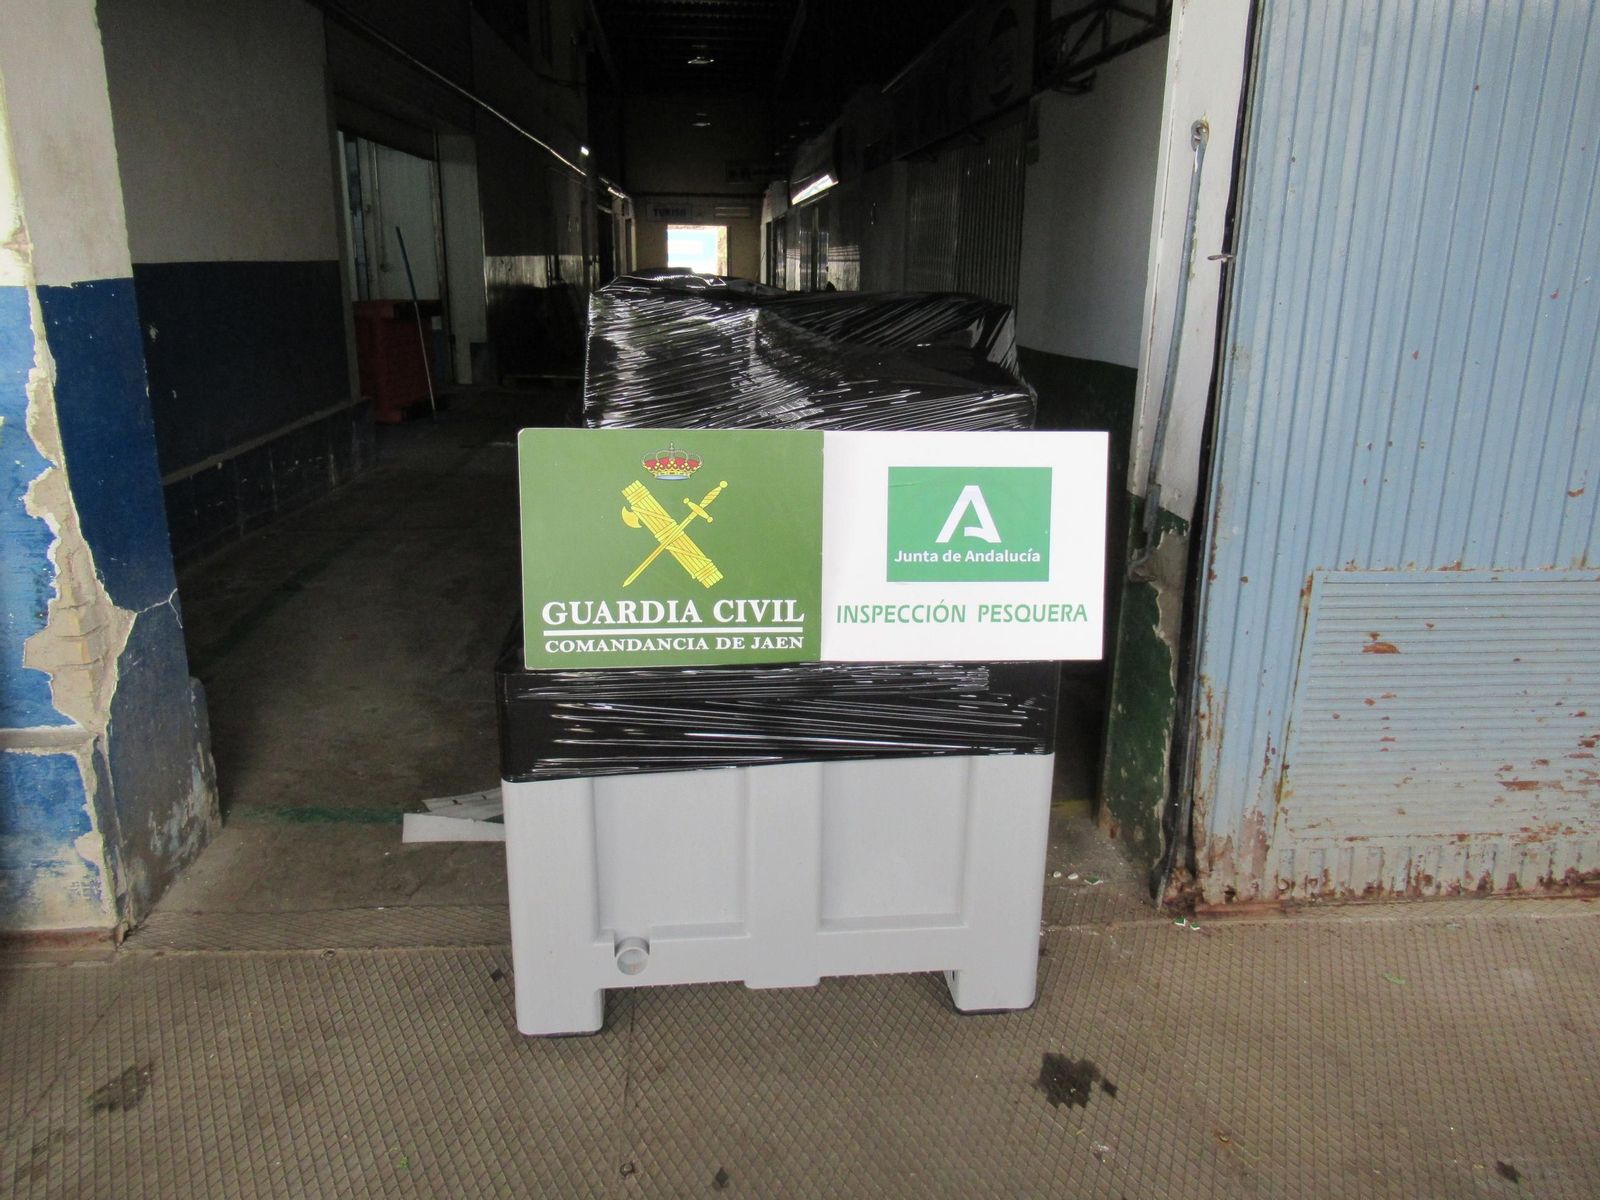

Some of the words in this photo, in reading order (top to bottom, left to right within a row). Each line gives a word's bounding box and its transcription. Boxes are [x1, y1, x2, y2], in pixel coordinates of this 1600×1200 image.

[894, 549, 938, 562] Junta
[942, 549, 962, 563] de
[964, 547, 1041, 563] Andalucía
[541, 599, 703, 626] GUARDIA
[713, 599, 805, 623] CIVIL
[836, 599, 966, 624] INSPECCIÓN
[977, 603, 1088, 623] PESQUERA
[544, 637, 710, 653] COMANDANCIA
[715, 637, 746, 650] DE
[750, 636, 805, 650] JAEN
